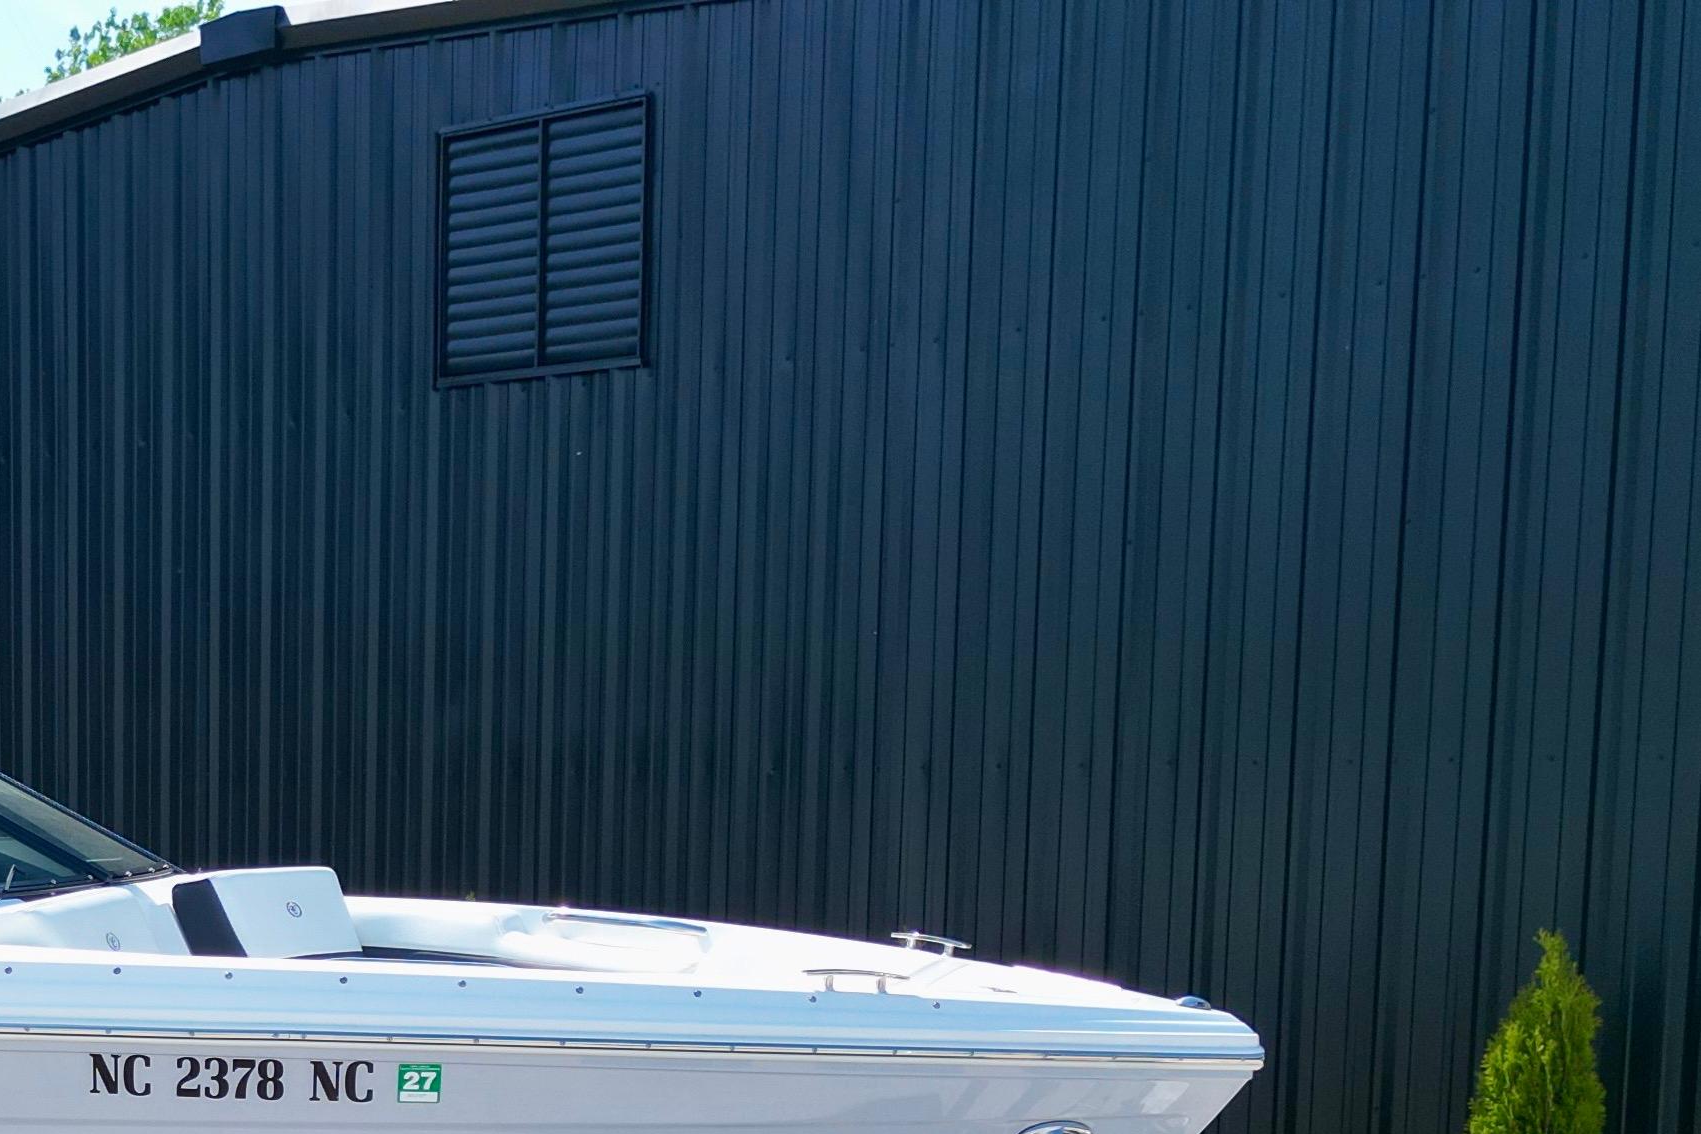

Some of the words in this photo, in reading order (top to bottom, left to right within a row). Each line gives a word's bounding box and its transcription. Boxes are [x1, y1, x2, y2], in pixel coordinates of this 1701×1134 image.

[89, 1053, 151, 1096] NC
[176, 1056, 285, 1101] 2378
[308, 1060, 374, 1103] NC
[402, 1071, 437, 1091] 27
